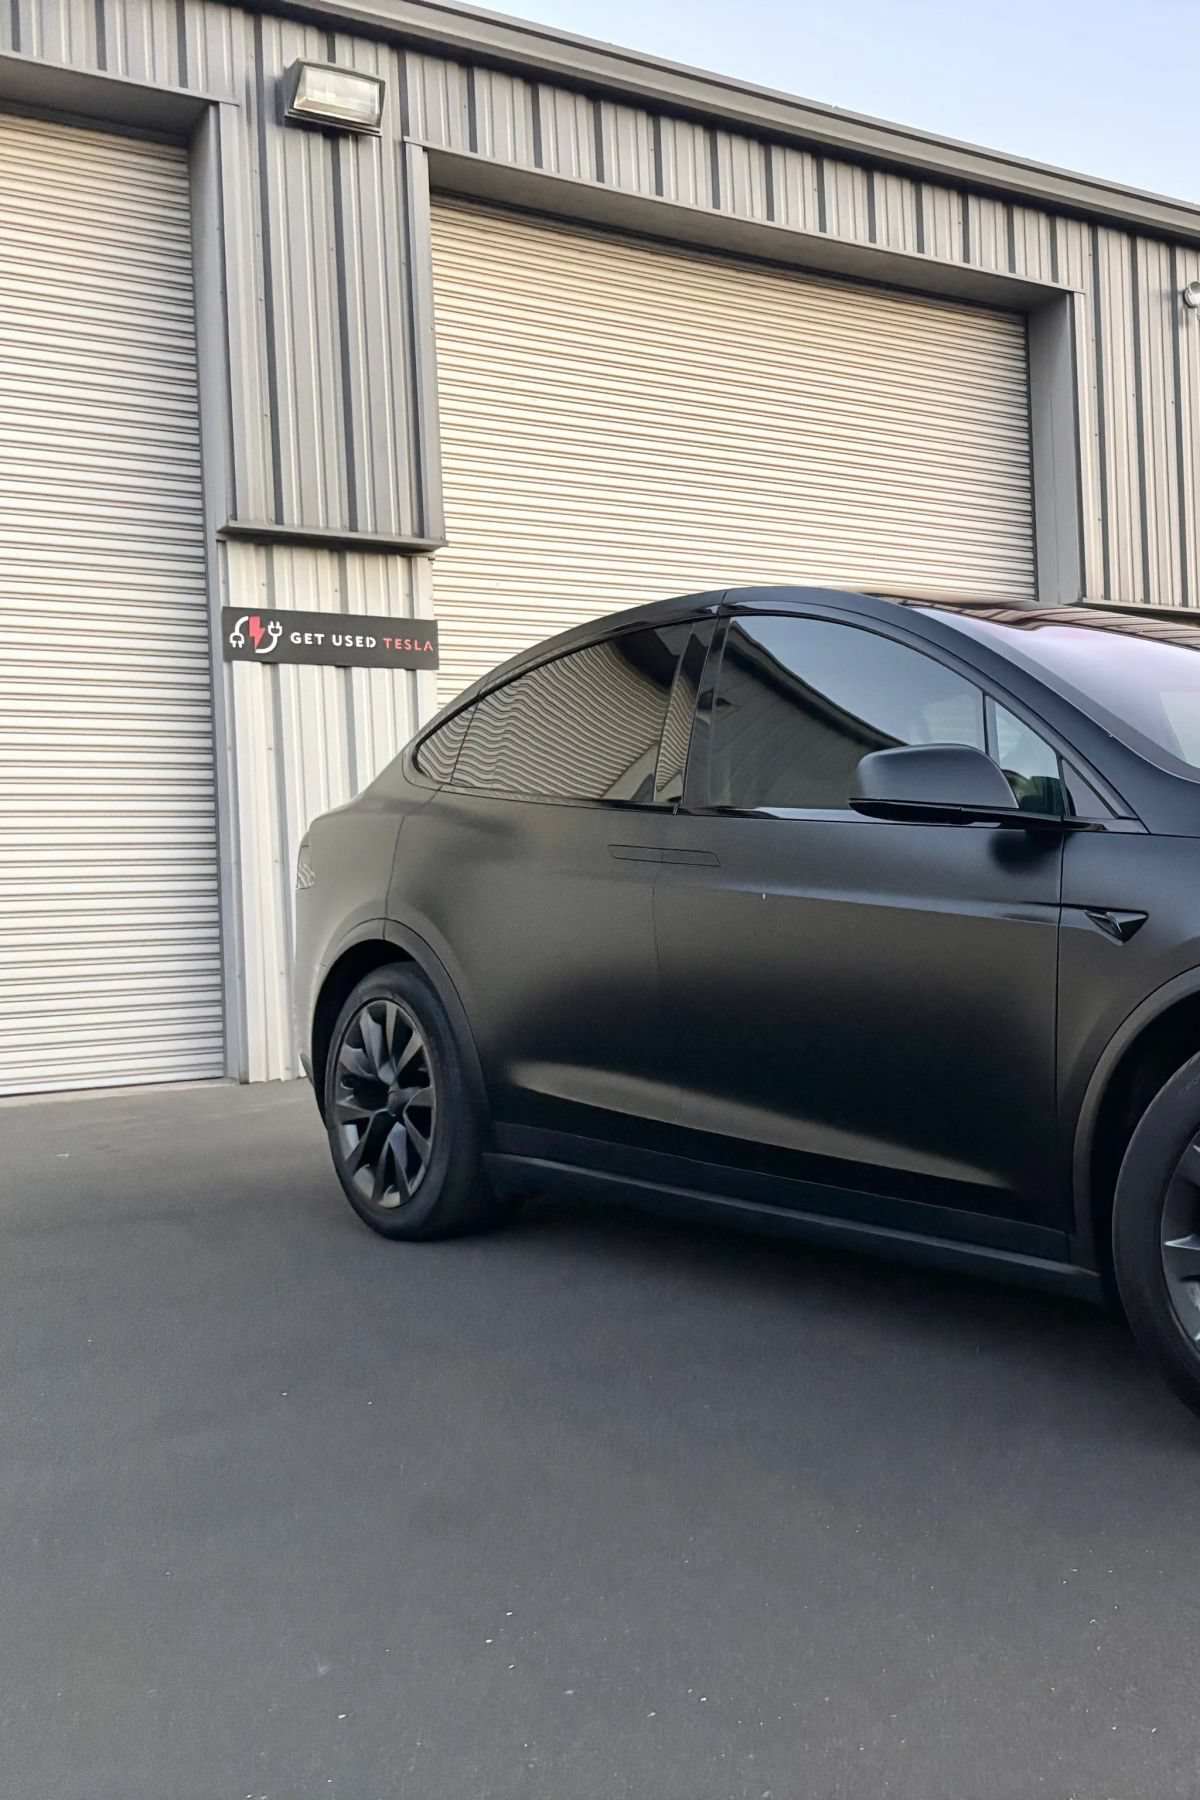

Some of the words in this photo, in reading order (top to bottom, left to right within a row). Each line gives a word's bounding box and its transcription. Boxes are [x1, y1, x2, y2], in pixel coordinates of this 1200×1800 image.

[290, 631, 325, 646] GET
[332, 633, 377, 649] USED
[383, 637, 434, 652] TESLA
